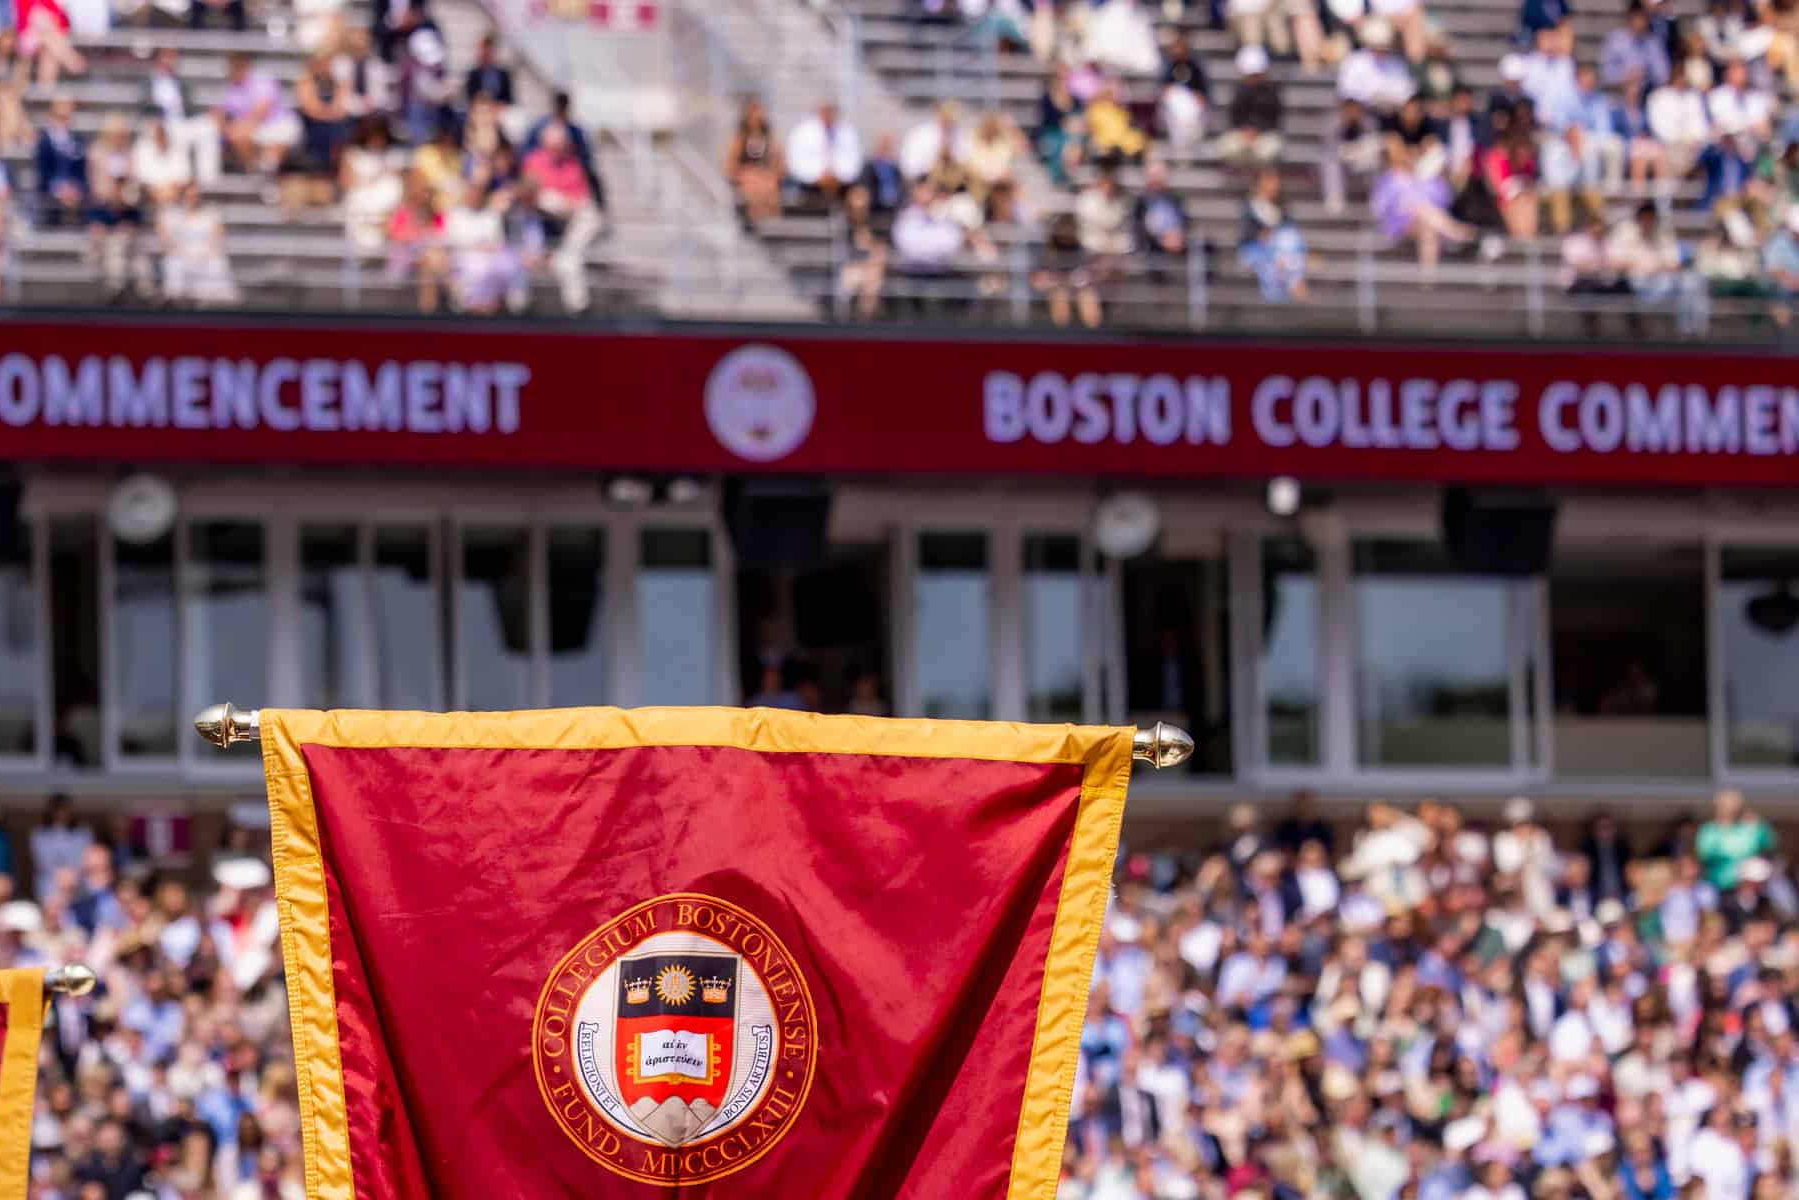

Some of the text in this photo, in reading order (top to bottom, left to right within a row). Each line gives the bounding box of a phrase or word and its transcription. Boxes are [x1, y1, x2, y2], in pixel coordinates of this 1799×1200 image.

[983, 371, 1232, 444] BOSTON
[1251, 376, 1519, 449] COLLEGE
[543, 904, 805, 1060] COLLEGIUM BOSTONIENSE
[602, 1096, 618, 1111] ET
[723, 1035, 768, 1118] BONIS ARTIBUS
[641, 1085, 796, 1175] MDCCCLXIII
